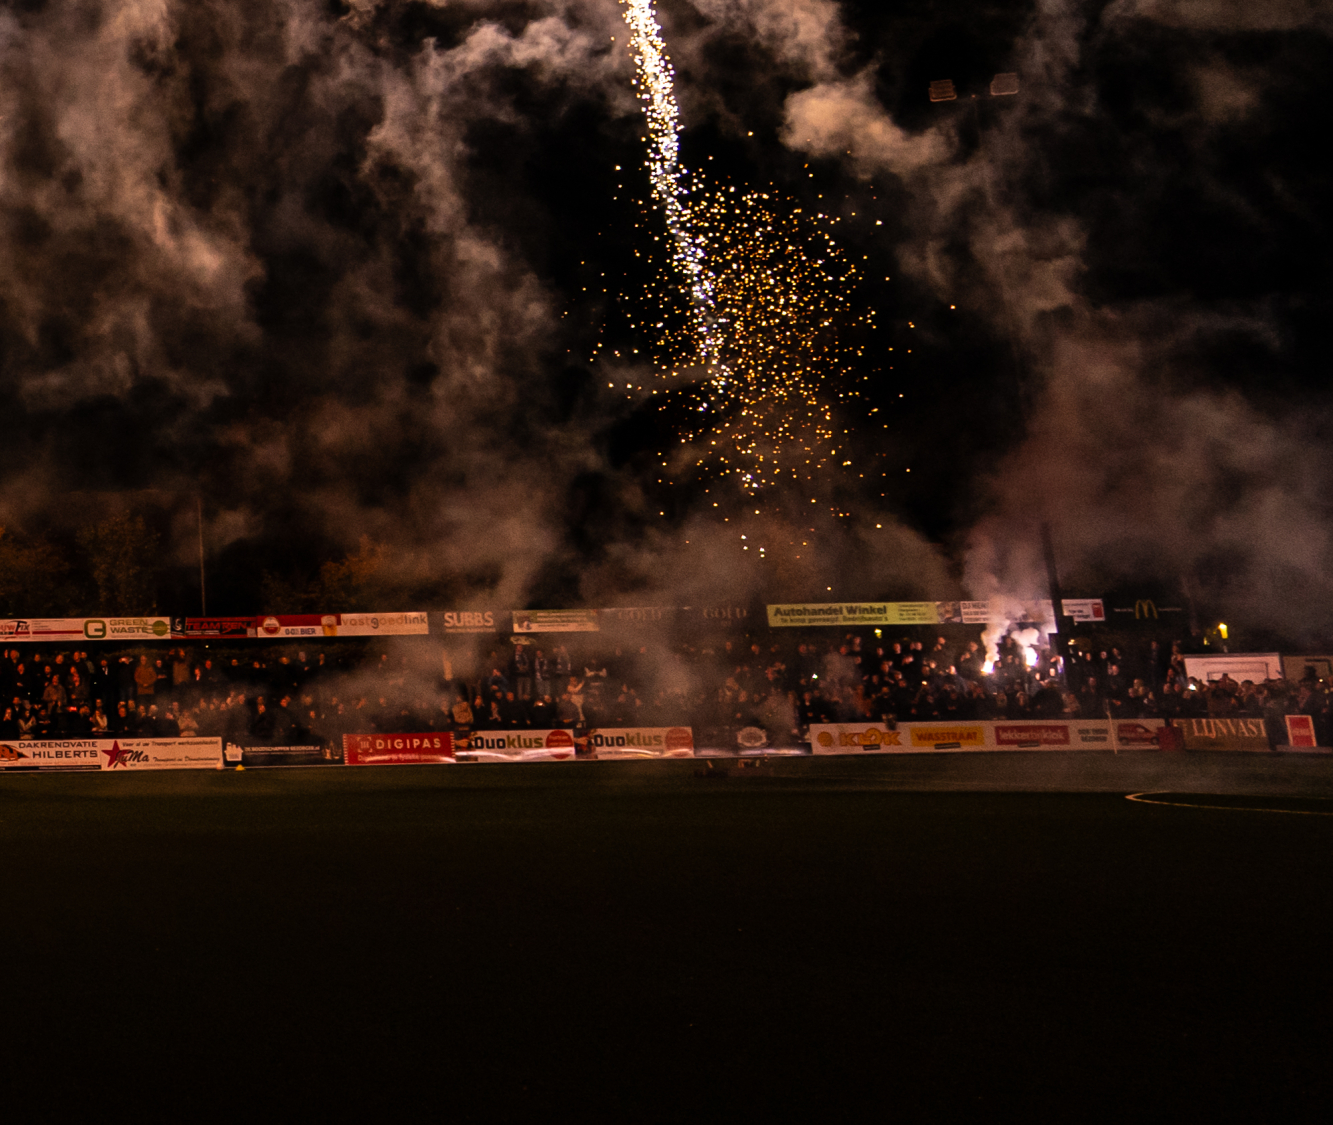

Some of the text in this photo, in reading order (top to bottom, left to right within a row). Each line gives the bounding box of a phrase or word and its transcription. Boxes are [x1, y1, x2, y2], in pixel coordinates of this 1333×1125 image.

[774, 606, 843, 616] Autohandel
[845, 605, 887, 615] Winkel
[342, 614, 427, 629] vastgoedlink
[443, 611, 494, 627] SUBBS
[110, 626, 148, 634] WASTE
[474, 734, 543, 749] Duoklus
[594, 733, 663, 747] Duoklus
[916, 731, 978, 741] WASSTRAAT
[18, 741, 98, 749] DAKRENOVATIE
[375, 738, 442, 750] DIGIPAS
[32, 749, 98, 759] HILBERTS
